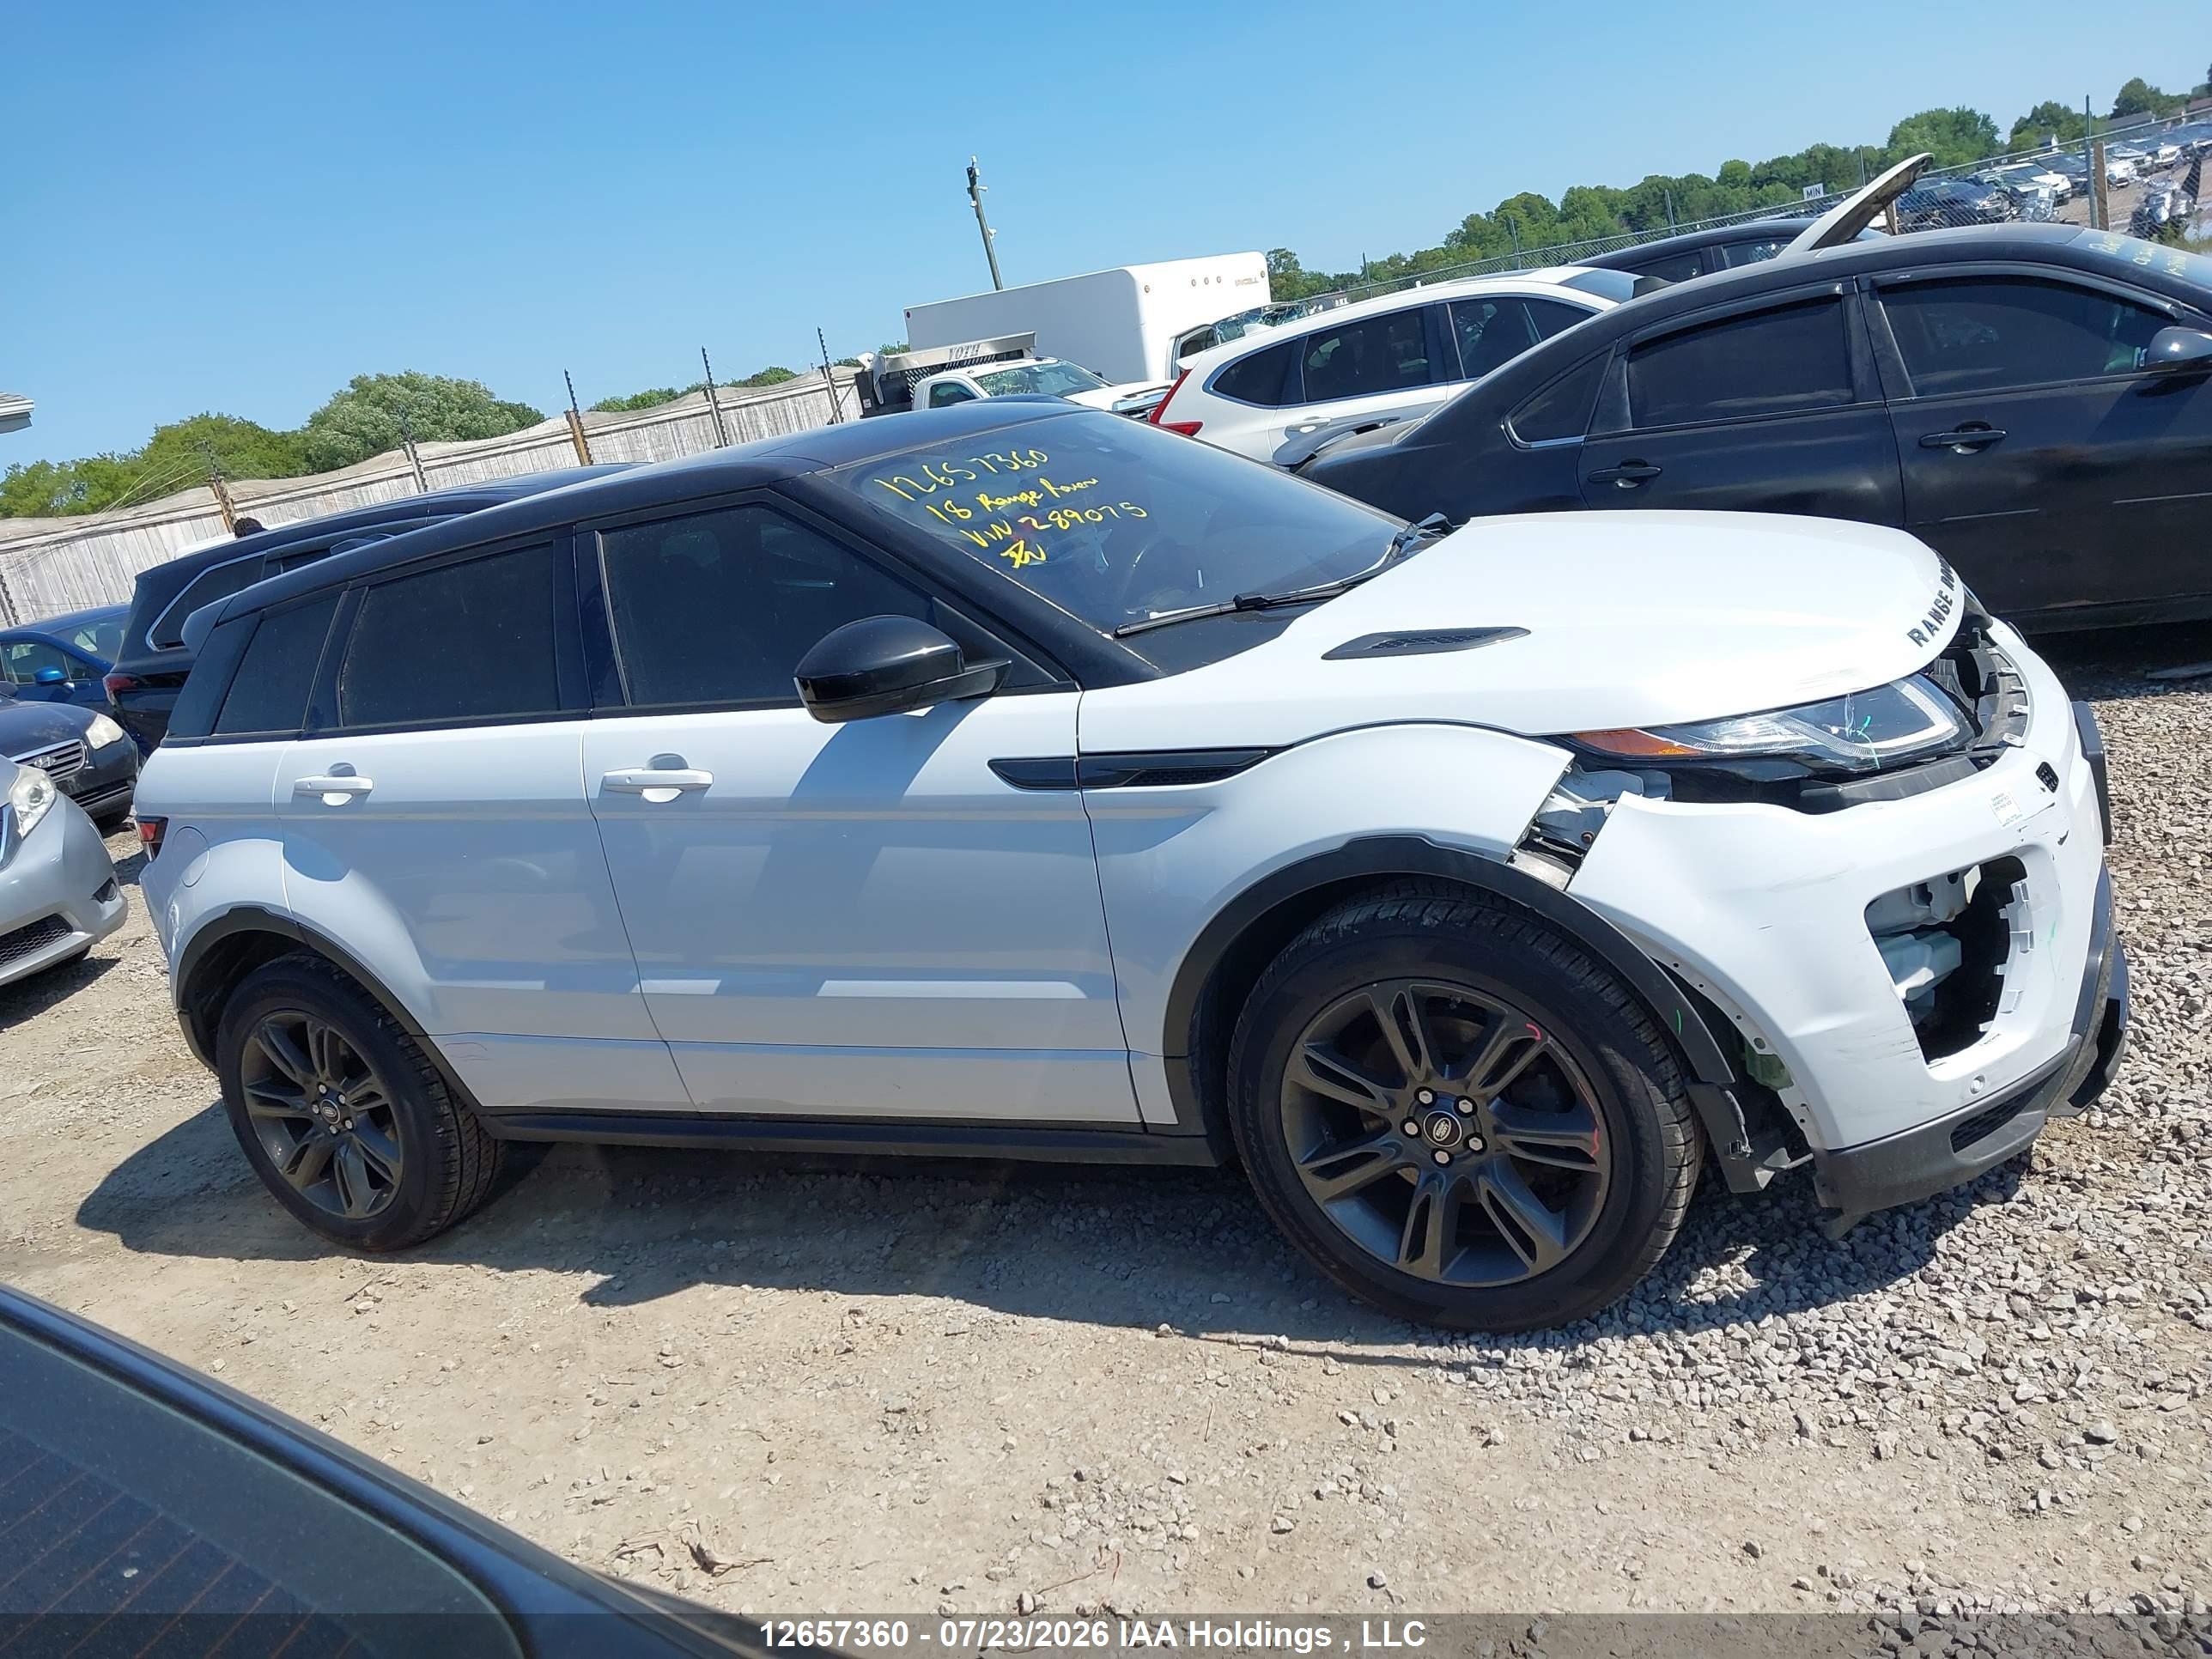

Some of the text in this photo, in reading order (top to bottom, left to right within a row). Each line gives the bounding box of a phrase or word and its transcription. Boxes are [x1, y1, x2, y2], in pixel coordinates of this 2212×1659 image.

[1806, 186, 1821, 199] MIN
[926, 500, 972, 525] 18
[959, 501, 1148, 547] VIN 289075
[1907, 590, 1954, 647] RANGE
